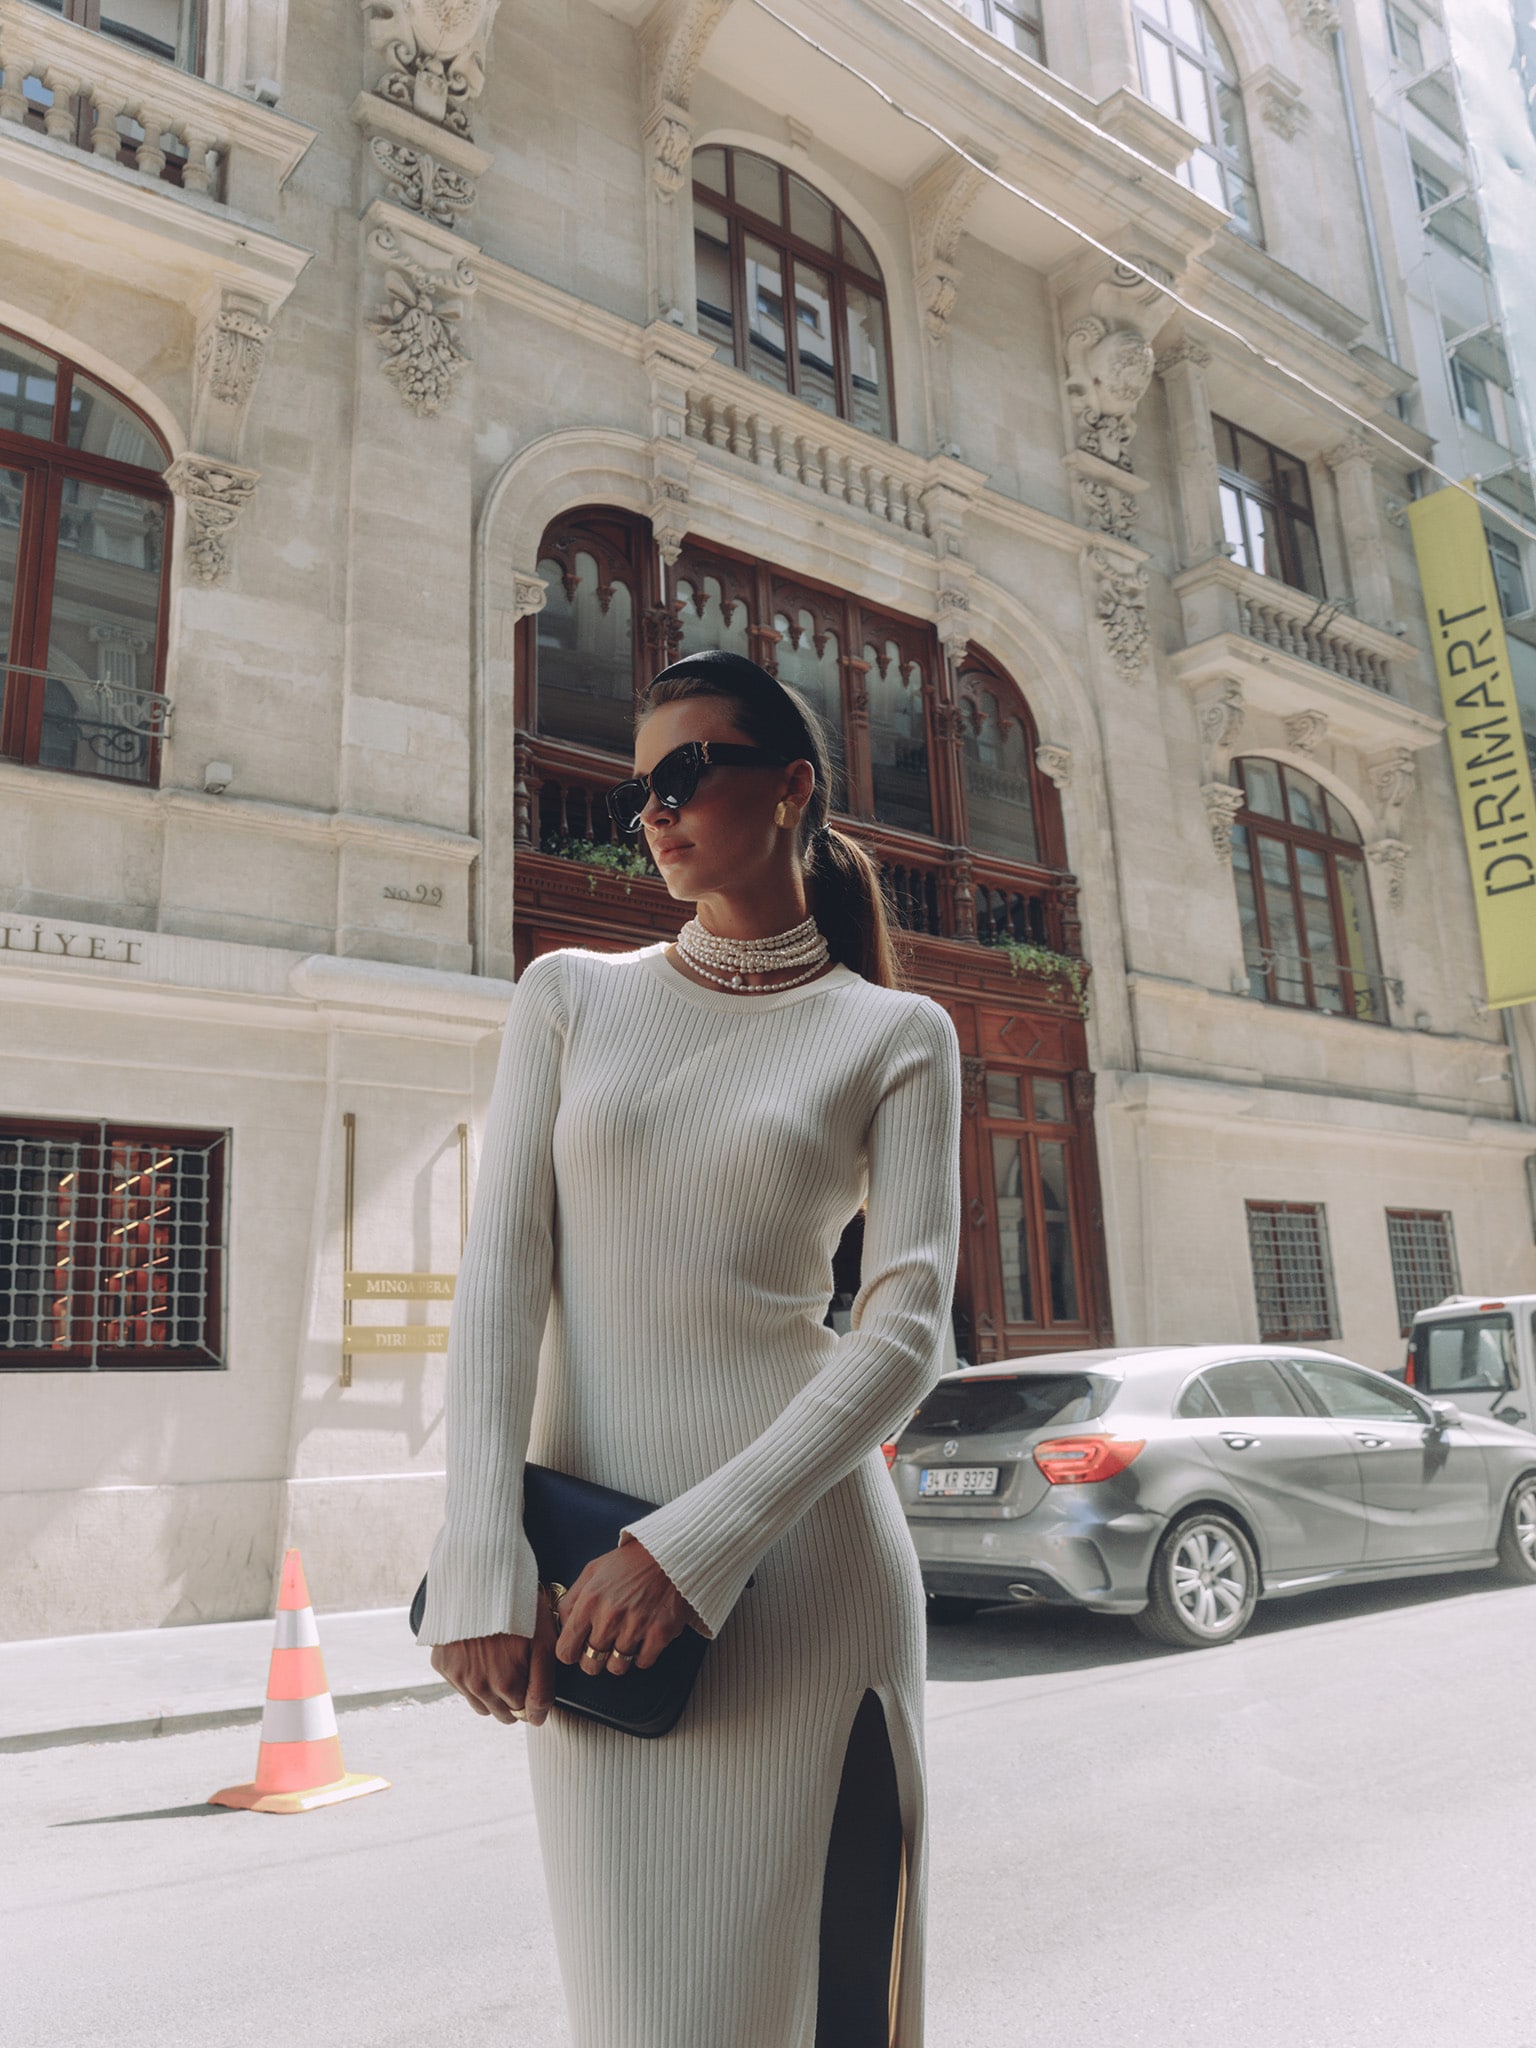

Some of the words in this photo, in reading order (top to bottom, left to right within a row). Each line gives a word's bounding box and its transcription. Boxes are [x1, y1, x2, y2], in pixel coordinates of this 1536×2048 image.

[366, 1279, 415, 1294] MINOA
[375, 1333, 444, 1347] DIRIRT
[928, 1472, 940, 1488] 34
[944, 1471, 959, 1488] KR
[963, 1471, 993, 1488] 9379
